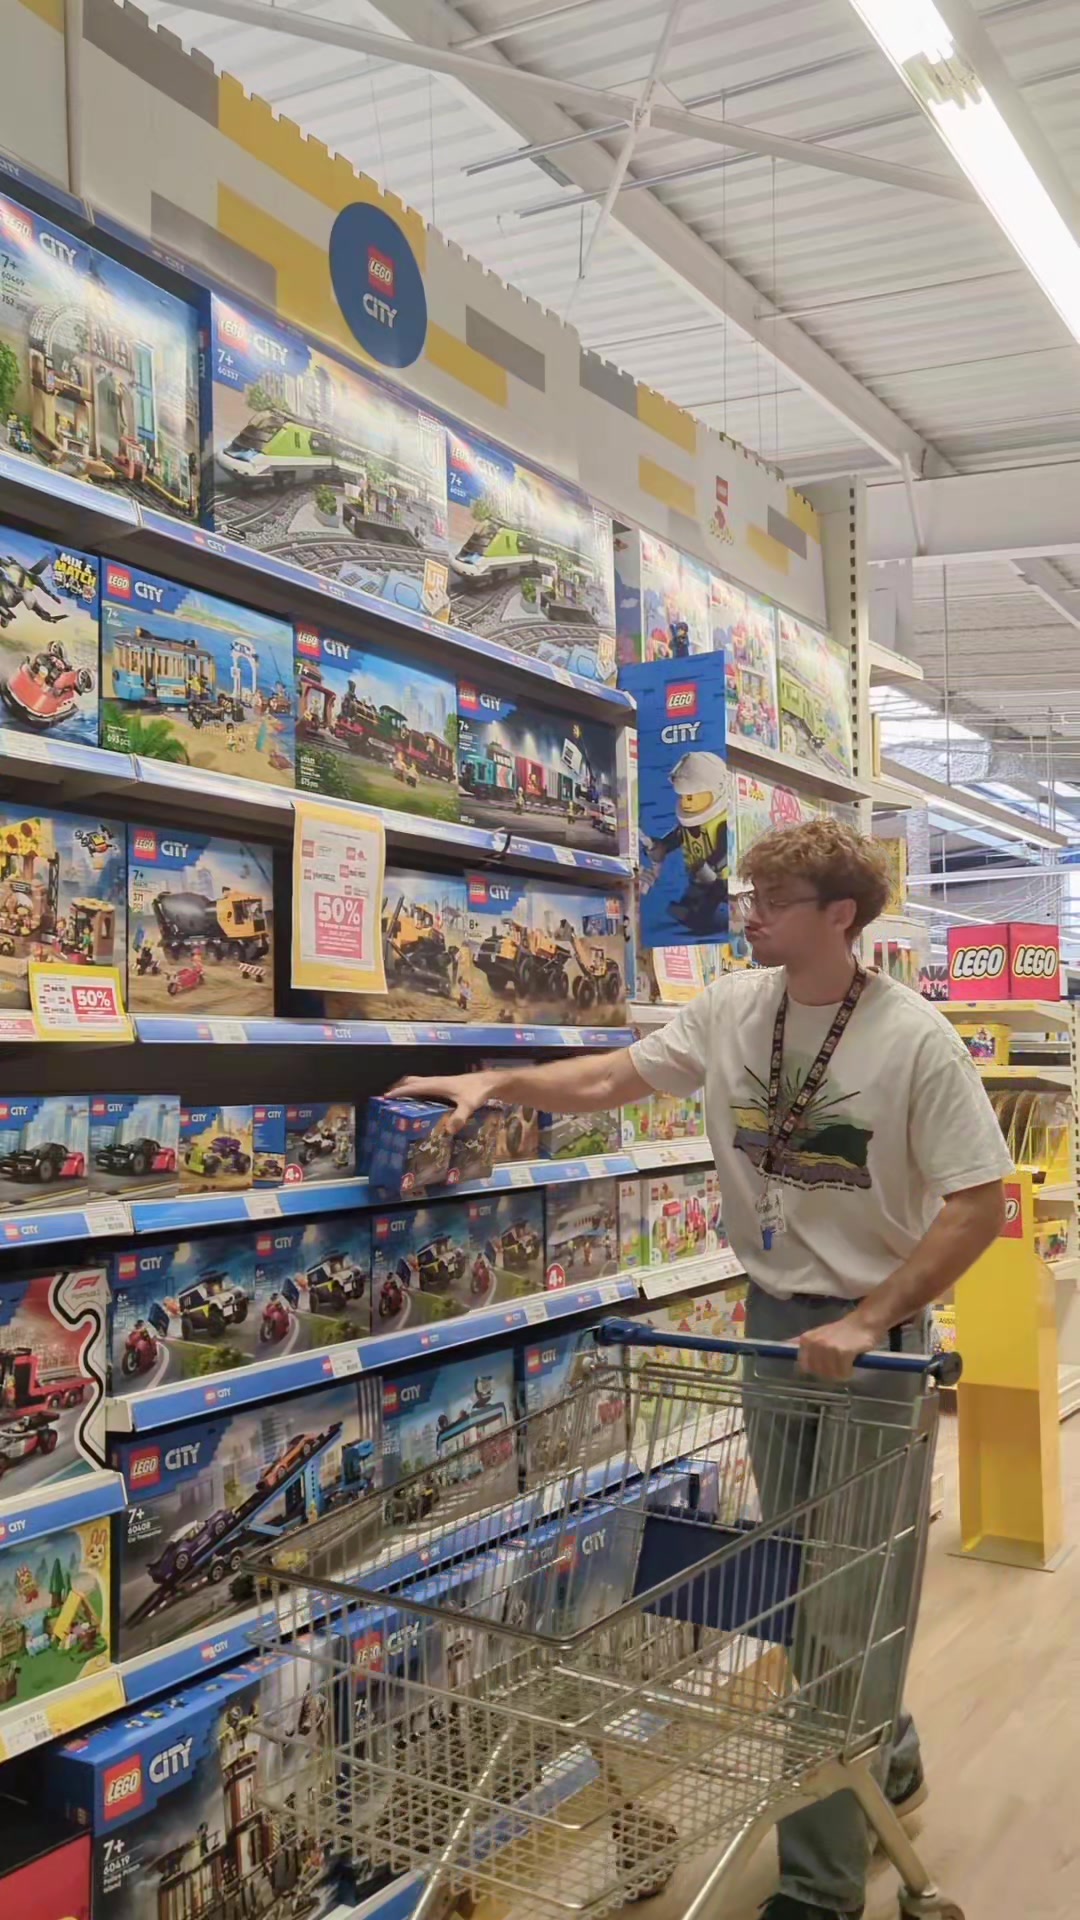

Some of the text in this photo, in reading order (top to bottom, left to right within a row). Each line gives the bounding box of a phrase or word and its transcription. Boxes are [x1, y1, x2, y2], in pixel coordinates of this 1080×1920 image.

[39, 233, 76, 266] CITY
[1, 253, 17, 269] 7+
[368, 258, 392, 285] LEGO
[363, 293, 397, 328] CITY
[254, 334, 288, 365] CITY
[218, 350, 233, 366] 7+
[450, 472, 462, 486] 7+
[60, 553, 82, 569] MIX
[54, 560, 96, 587] MATCH
[108, 575, 163, 603] LEGO CITY
[106, 608, 118, 618] 7+
[299, 631, 350, 659] LEGO CITY
[297, 664, 310, 675] 7+
[480, 693, 501, 711] CITY
[668, 692, 693, 707] LEGO
[459, 720, 469, 730] 7+
[661, 723, 700, 744] CITY
[136, 839, 189, 858] LEGO CITY
[133, 870, 144, 880] 7+
[490, 885, 510, 900] CITY
[318, 895, 360, 925] 50%
[952, 946, 1004, 979] LEGO
[1014, 946, 1056, 978] LEGO
[76, 989, 111, 1007] 50%
[10, 1106, 28, 1116] CITY
[107, 1103, 123, 1112] CITY
[268, 1111, 281, 1119] CITY
[191, 1113, 206, 1122] CITY
[285, 1169, 299, 1180] 4+
[390, 1220, 406, 1231] CITY
[275, 1236, 293, 1248] CITY
[140, 1256, 163, 1270] CITY
[549, 1271, 563, 1286] 4+
[400, 1385, 421, 1401] CITY
[131, 1441, 201, 1479] LEGO CITY
[128, 1508, 144, 1524] 7+
[8, 1519, 26, 1533] CITY
[582, 1529, 606, 1555] CITY
[105, 1736, 193, 1804] LEGO CITY
[103, 1839, 125, 1860] 7+
